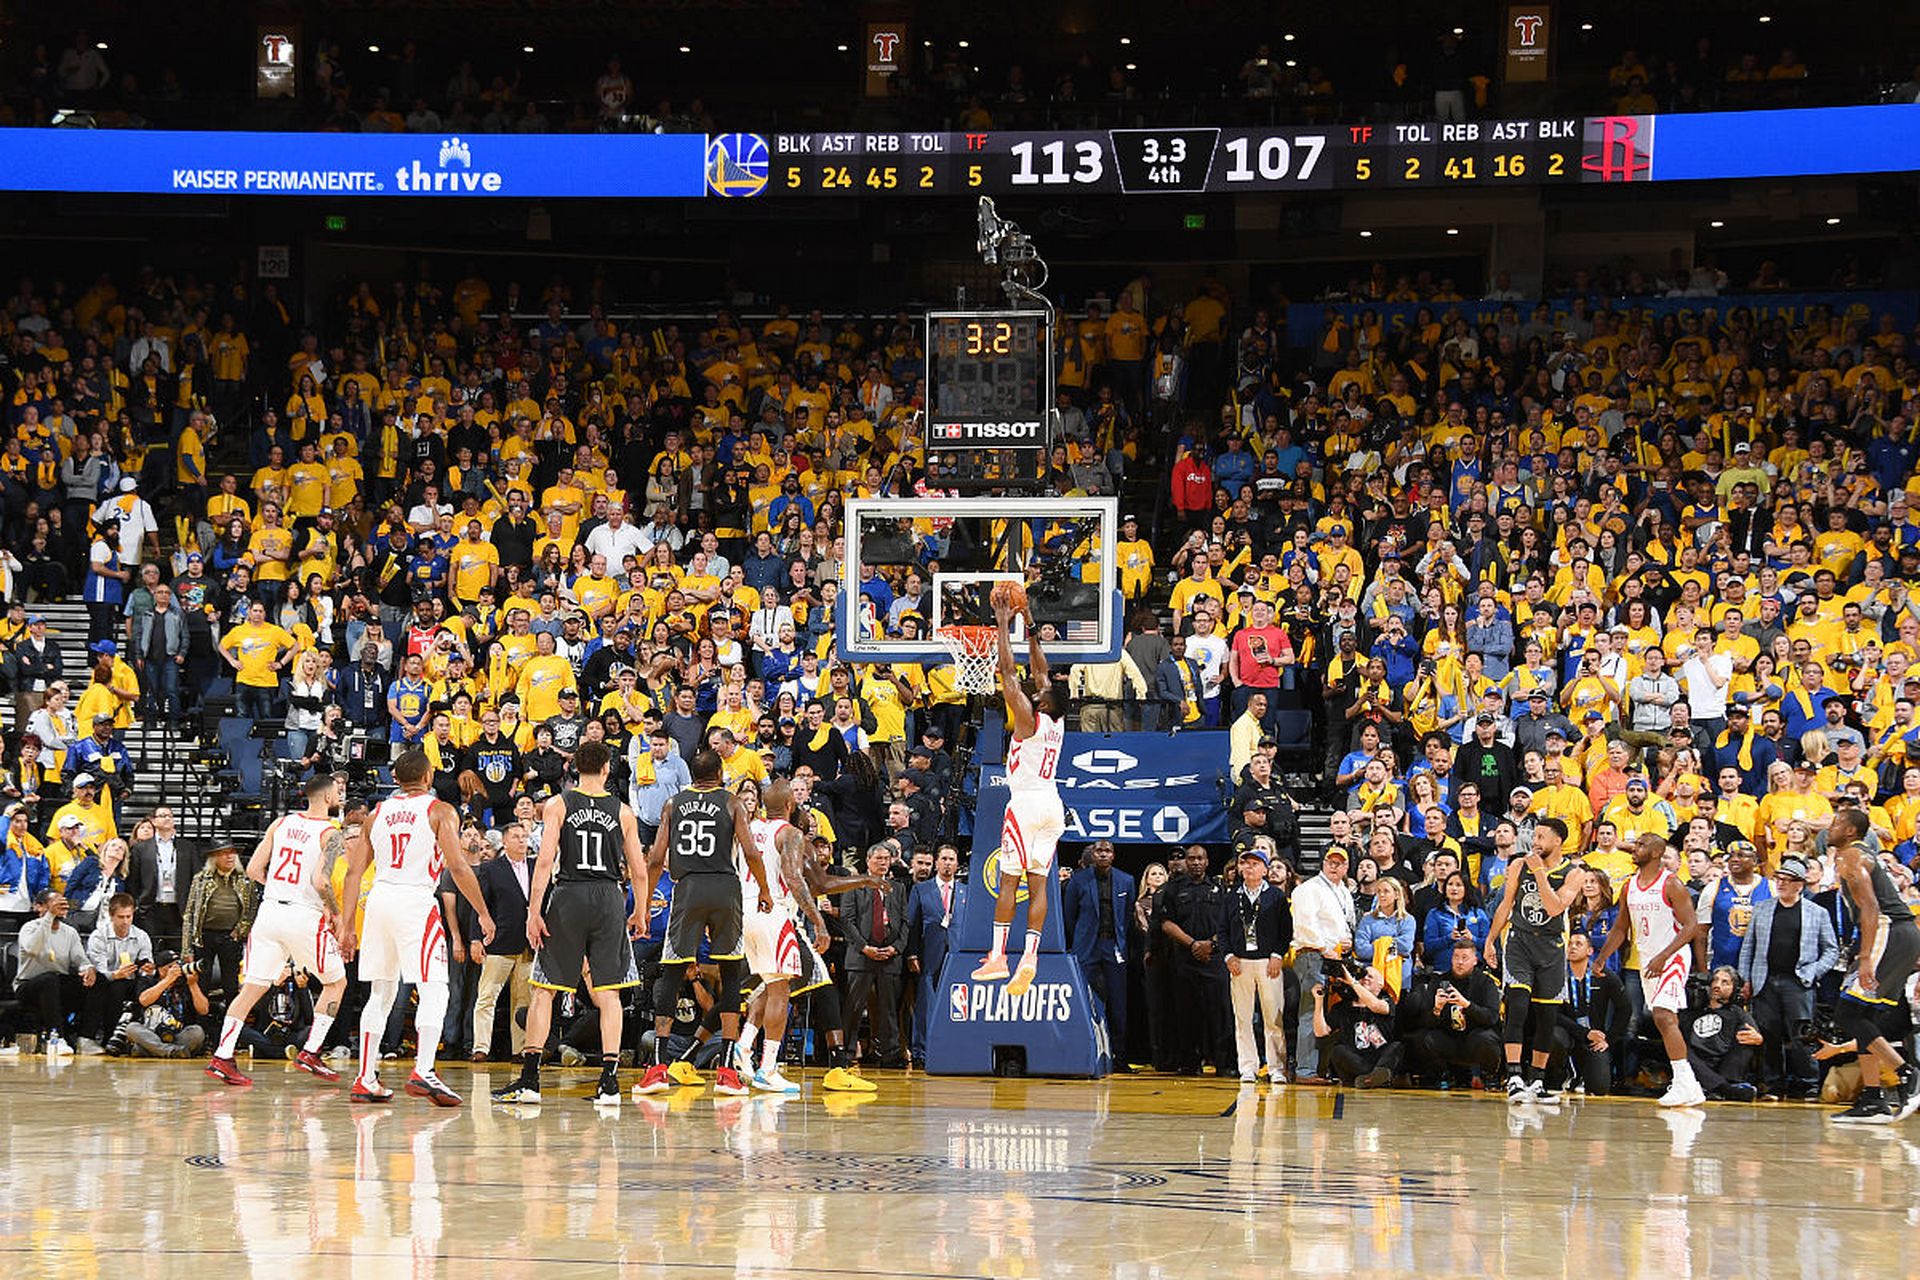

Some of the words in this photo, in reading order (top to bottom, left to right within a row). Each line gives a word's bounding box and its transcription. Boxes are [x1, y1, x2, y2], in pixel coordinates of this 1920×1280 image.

[778, 136, 810, 153] BLK
[822, 136, 854, 152] AST
[866, 135, 899, 152] REB
[911, 135, 942, 152] TOL
[965, 134, 988, 151] TF
[1350, 126, 1373, 144] TF
[1395, 126, 1430, 142] TOL
[1443, 123, 1479, 141] REB
[1492, 122, 1528, 140] AST
[1539, 120, 1575, 138] BLK
[1011, 140, 1104, 185] 113
[1142, 137, 1187, 164] 3.3
[1225, 136, 1327, 182] 107
[395, 160, 503, 192] thrive
[787, 167, 801, 188] 5
[822, 167, 852, 188] 24
[866, 166, 897, 188] 45
[919, 166, 935, 187] 2
[969, 165, 985, 186] 5
[1147, 164, 1181, 184] 4th
[1356, 158, 1372, 180] 5
[1403, 157, 1419, 180] 2
[1443, 156, 1477, 179] 41
[1493, 154, 1526, 177] 16
[1547, 153, 1565, 176] 2
[172, 169, 238, 190] KAISER
[966, 322, 1012, 355] 3.2
[962, 423, 1040, 439] TISSOT
[1039, 746, 1056, 780] 13
[1057, 774, 1200, 790] HASE
[385, 811, 416, 828] GORDON
[567, 809, 618, 832] THOMPSON
[679, 801, 719, 817] DURANT
[1064, 807, 1142, 839] ASE
[576, 829, 607, 873] 11
[677, 820, 717, 858] 35
[273, 846, 302, 884] 25
[1528, 911, 1543, 923] 30
[1641, 916, 1650, 937] 3
[970, 984, 1074, 1022] PLAYOFFS
